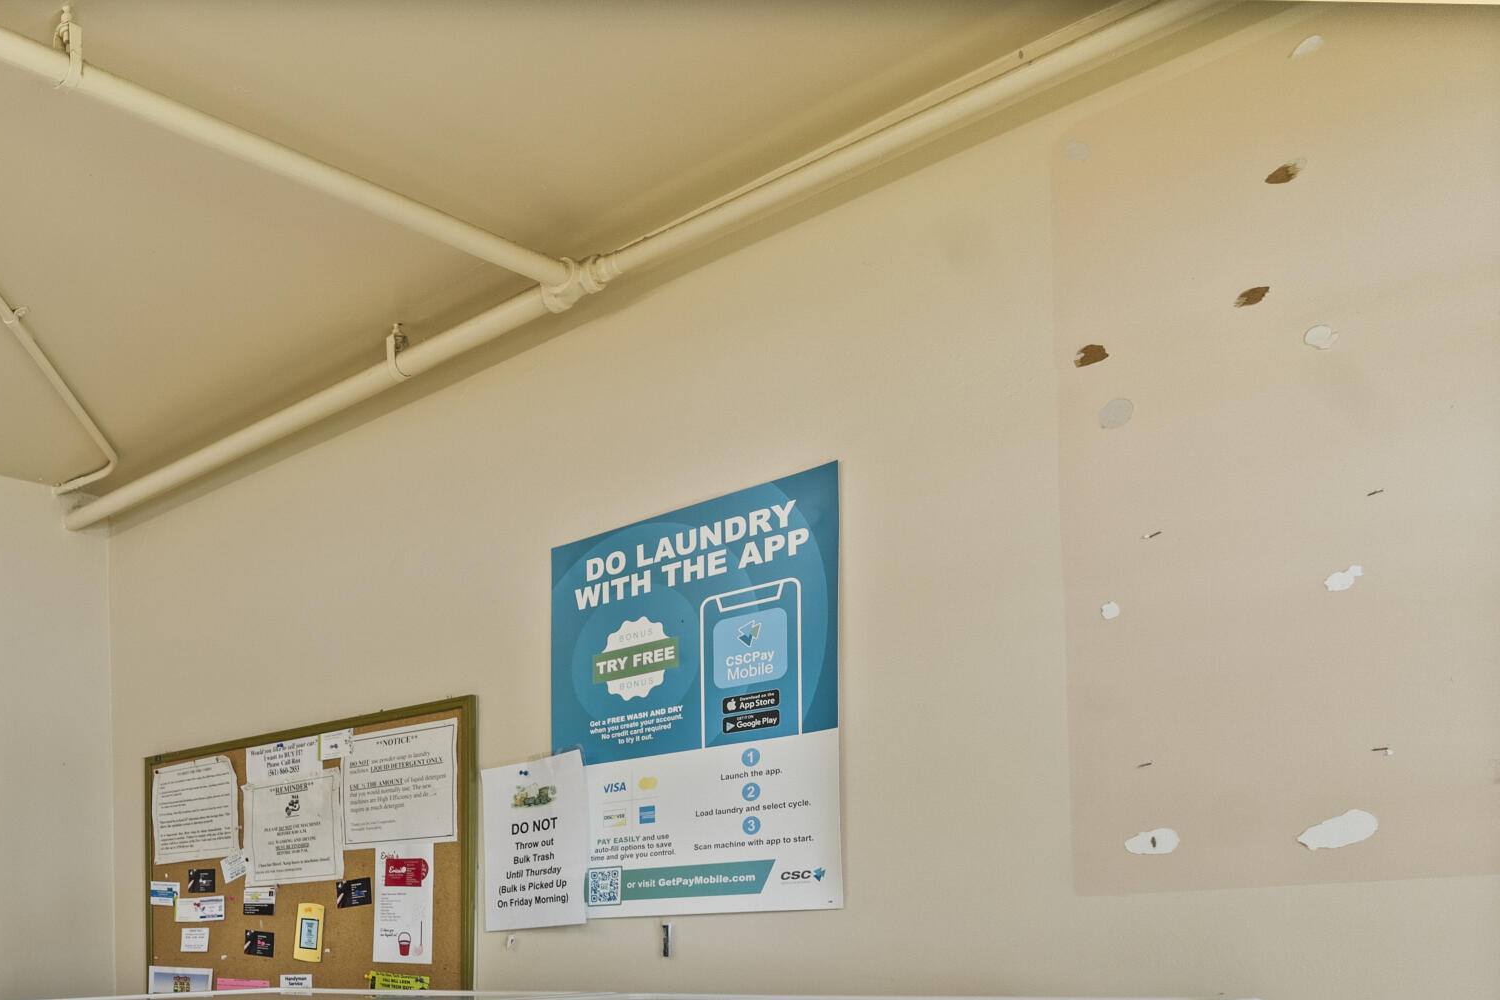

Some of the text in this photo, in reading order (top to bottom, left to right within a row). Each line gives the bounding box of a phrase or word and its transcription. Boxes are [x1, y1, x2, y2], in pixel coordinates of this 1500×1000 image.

[586, 500, 796, 582] DO LAUNDRY
[574, 528, 809, 610] WITH THE APP
[619, 628, 653, 643] BONUS
[596, 646, 675, 675] TRY FREE
[726, 651, 775, 666] CSCPay
[728, 663, 773, 680] Mobile
[619, 678, 654, 691] BONUS
[740, 698, 775, 709] App Store
[607, 716, 625, 724] FREE
[627, 712, 648, 720] WASH
[668, 705, 683, 713] DRY
[608, 725, 619, 733] you
[620, 721, 639, 729] create
[656, 714, 683, 723] account.
[737, 719, 760, 728] Google
[612, 730, 628, 738] credit
[645, 723, 671, 732] required
[748, 752, 753, 763] 1
[720, 771, 748, 780] Launch
[604, 782, 626, 793] VISA
[747, 786, 755, 798] 2
[696, 809, 713, 817] Load
[716, 807, 743, 815] laundry
[763, 802, 786, 810] select
[788, 800, 811, 808] cycle.
[512, 817, 557, 835] DO NOT
[748, 820, 756, 831] 3
[516, 838, 554, 850] Throw out
[621, 843, 645, 851] options
[714, 841, 745, 849] machine
[748, 838, 763, 846] with
[514, 852, 554, 864] Bulk Trash
[506, 866, 561, 879] Until Thursday
[780, 871, 811, 880] CSC
[499, 885, 517, 895] (Bulk
[528, 880, 554, 891] Picked
[556, 879, 567, 888] Up
[638, 880, 655, 888] visit
[658, 874, 755, 886] GetPayMobile.com
[498, 893, 568, 908] On Friday Morning)
